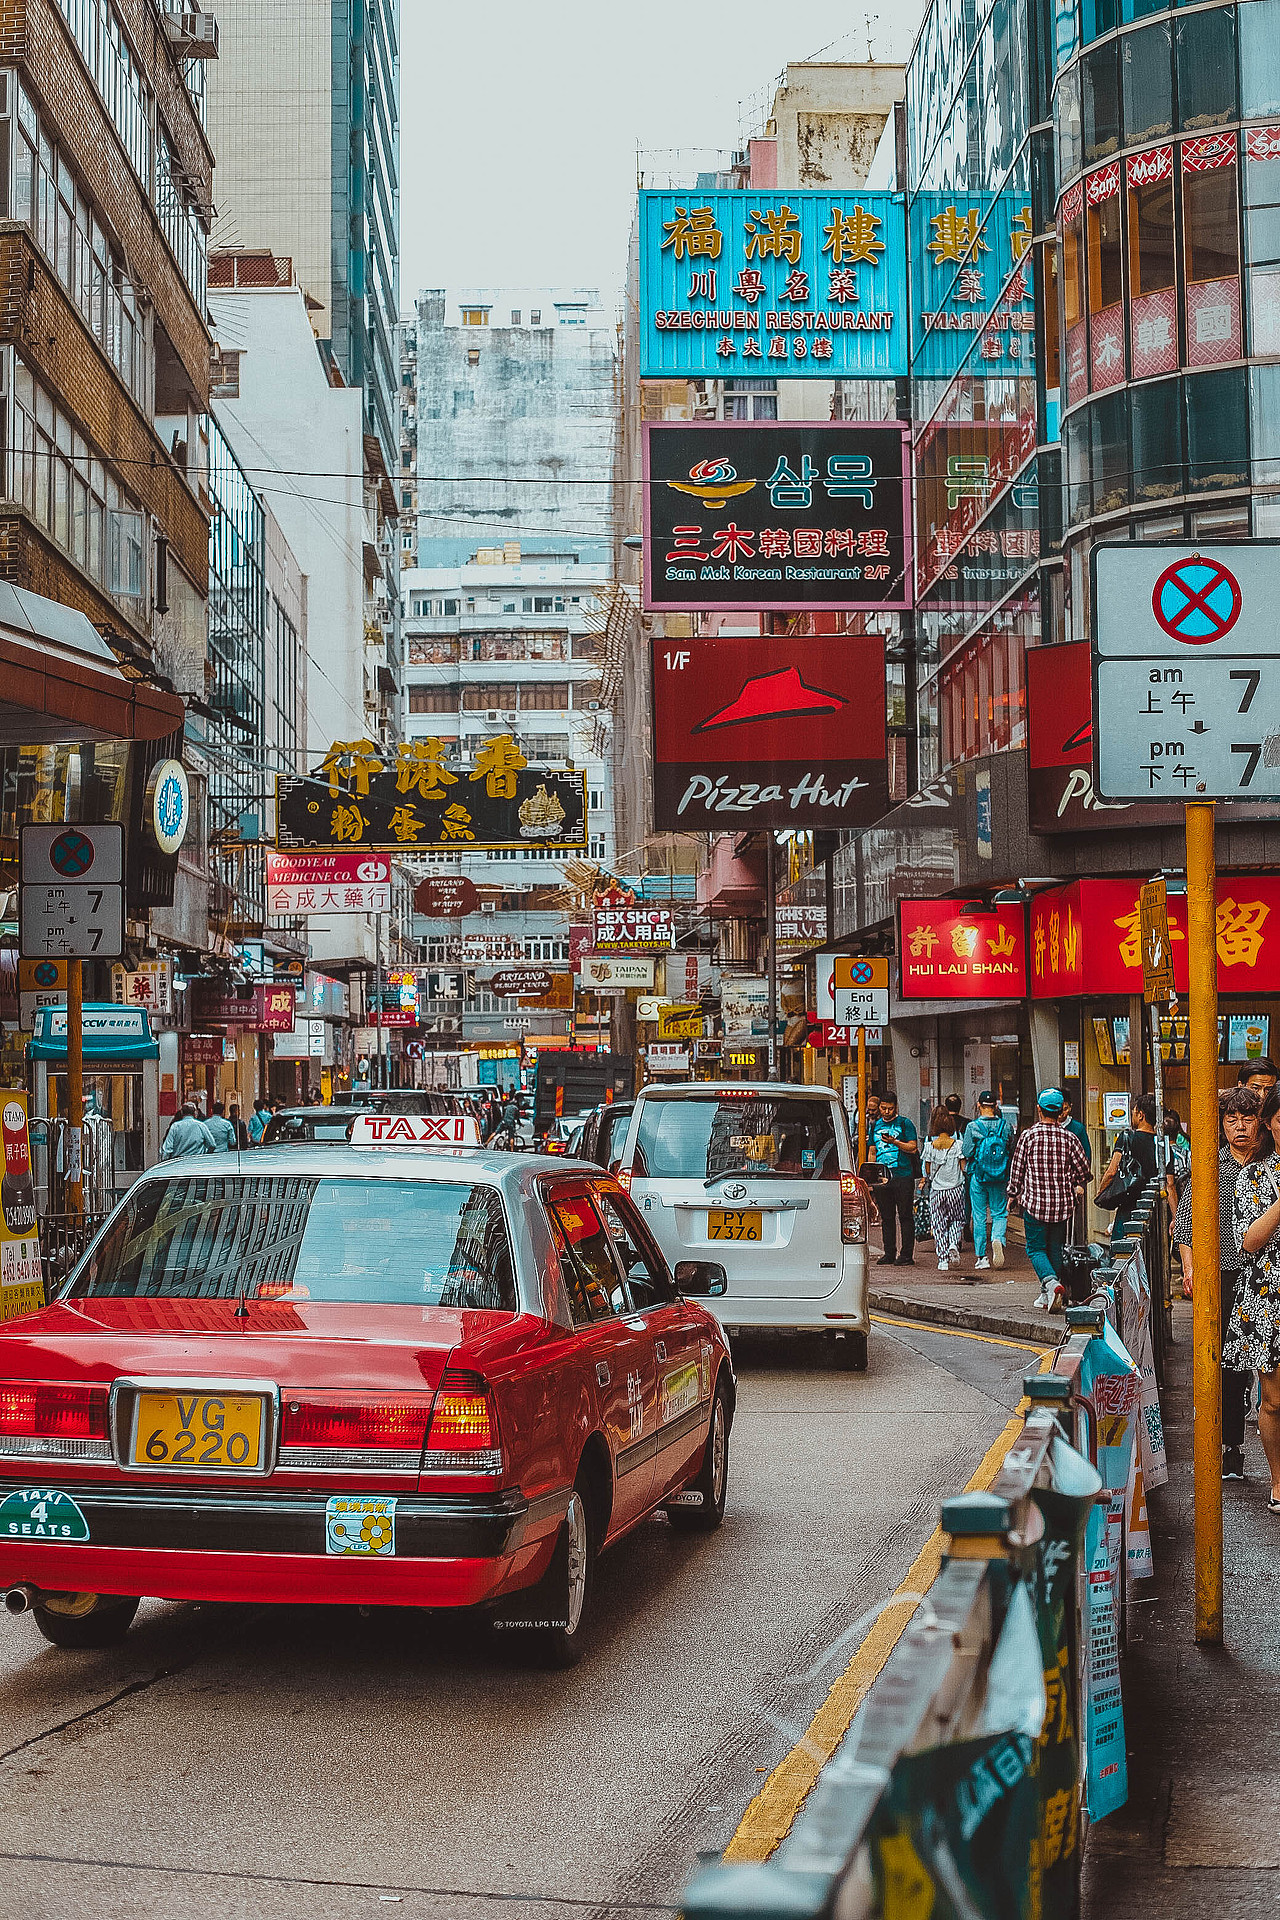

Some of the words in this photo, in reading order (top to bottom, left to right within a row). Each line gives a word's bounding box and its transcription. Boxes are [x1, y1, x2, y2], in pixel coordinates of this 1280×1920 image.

[1090, 175, 1117, 199] Sam
[1132, 156, 1167, 181] Mok
[661, 206, 886, 265] 福滿樓
[655, 311, 759, 330] SZECHUEN
[765, 311, 893, 331] RESTAURANT
[716, 336, 833, 359] 本大廈3樓
[765, 454, 878, 511] 삼목
[665, 566, 696, 581] Sam
[700, 566, 730, 581] Mok
[733, 566, 781, 581] Korean
[785, 566, 861, 581] Restaurant
[864, 566, 890, 581] 2/F
[663, 651, 691, 671] 1/F
[1149, 668, 1183, 683] am
[1229, 669, 1261, 713] 7
[1138, 690, 1196, 714] 上午
[1150, 741, 1185, 760] pm
[1230, 743, 1262, 787] 7
[1139, 763, 1197, 789] 下午
[677, 775, 784, 816] Pizza
[787, 772, 870, 808] Hut
[271, 857, 337, 869] GOODYEAR
[271, 870, 330, 883] MEDICINE
[333, 870, 353, 881] CO.
[47, 889, 65, 898] am
[87, 890, 104, 914] 7
[271, 886, 387, 910] 合成大藥行
[41, 901, 71, 914] 上午
[596, 911, 625, 924] SEX
[626, 910, 671, 924] SHOP
[47, 927, 65, 938] pm
[87, 929, 104, 952] 7
[596, 924, 671, 942] 成人用品
[907, 924, 1017, 958] 許留山
[41, 939, 71, 953] 下午
[596, 940, 671, 950] WWW.TAKETOYS.HK
[499, 971, 545, 981] ARTLAND
[909, 964, 934, 975] HUI
[938, 963, 969, 975] LAU
[972, 962, 1014, 974] SHAN
[35, 994, 59, 1006] End
[851, 993, 874, 1003] End
[845, 1005, 880, 1022] 終止
[81, 1019, 107, 1028] CCW
[827, 1026, 847, 1040] 24
[729, 1053, 756, 1065] THIS
[364, 1117, 465, 1141] TAXI
[723, 1211, 746, 1226] PY
[711, 1226, 758, 1241] 7376
[177, 1398, 225, 1431] VG
[145, 1429, 250, 1464] 6220
[19, 1490, 63, 1505] TAXI
[30, 1501, 49, 1523] 4
[8, 1522, 72, 1536] SEATS
[505, 1620, 533, 1628] TOYOTA
[534, 1620, 550, 1628] LPG
[551, 1620, 567, 1628] TAXI
